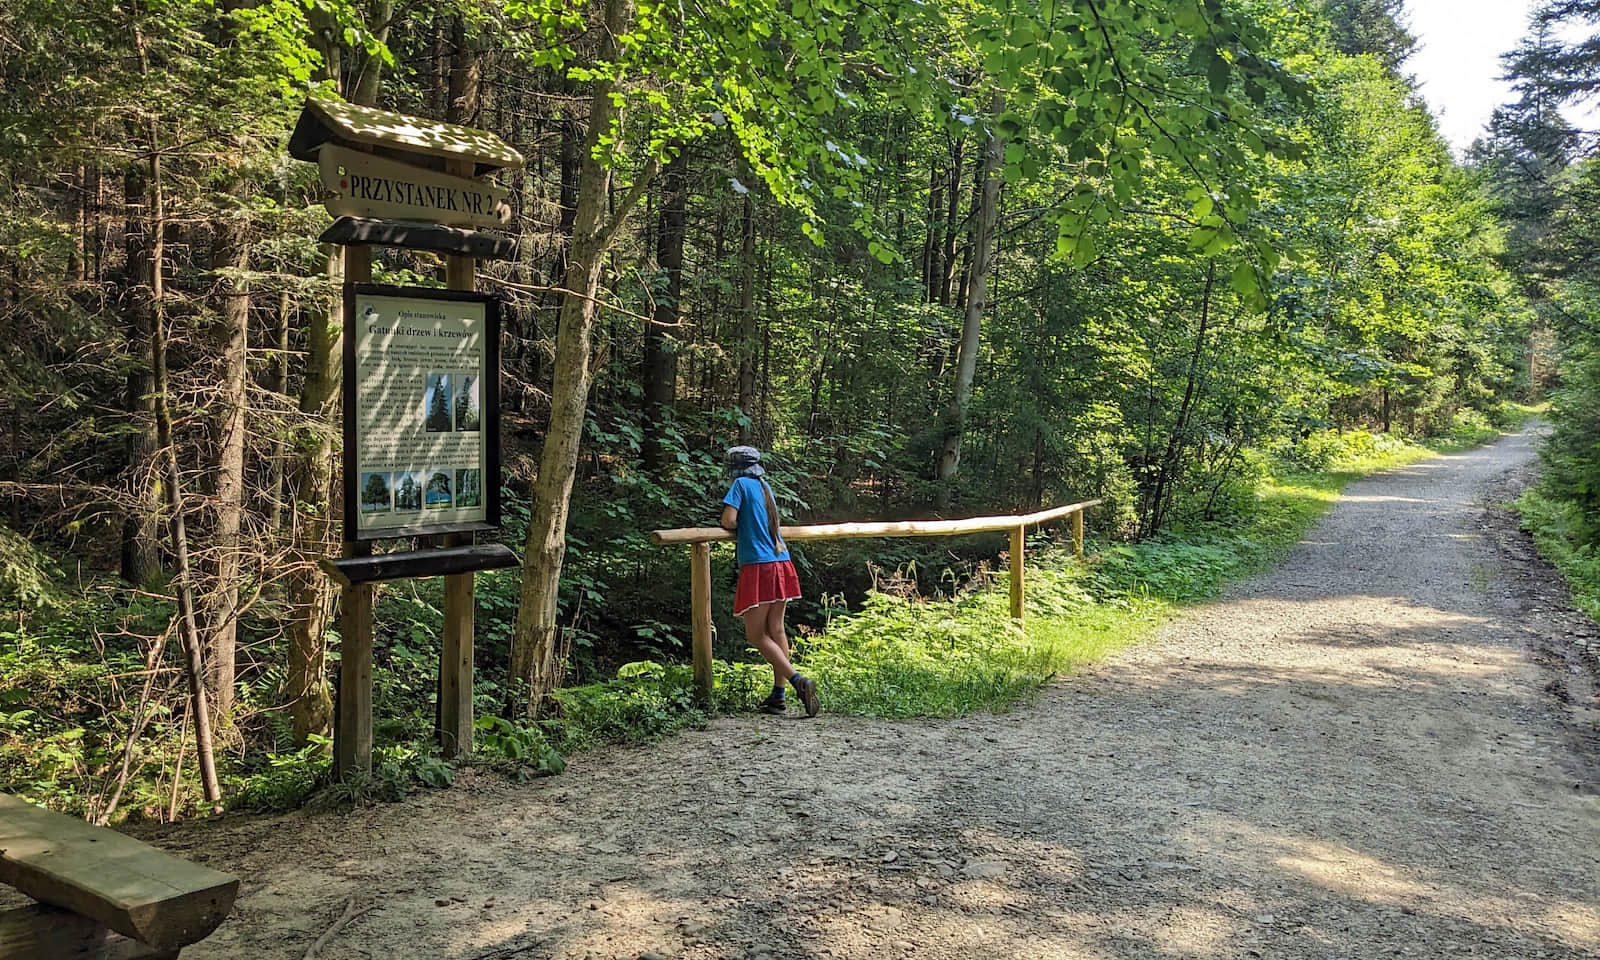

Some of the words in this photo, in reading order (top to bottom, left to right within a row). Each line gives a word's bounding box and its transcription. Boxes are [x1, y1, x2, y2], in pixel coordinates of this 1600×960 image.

[351, 174, 458, 212] PRZYSTANEK
[462, 191, 482, 215] NR
[486, 194, 494, 216] 2
[368, 325, 404, 337] Gatunki
[406, 326, 431, 337] drzew
[439, 328, 473, 338] krzewów
